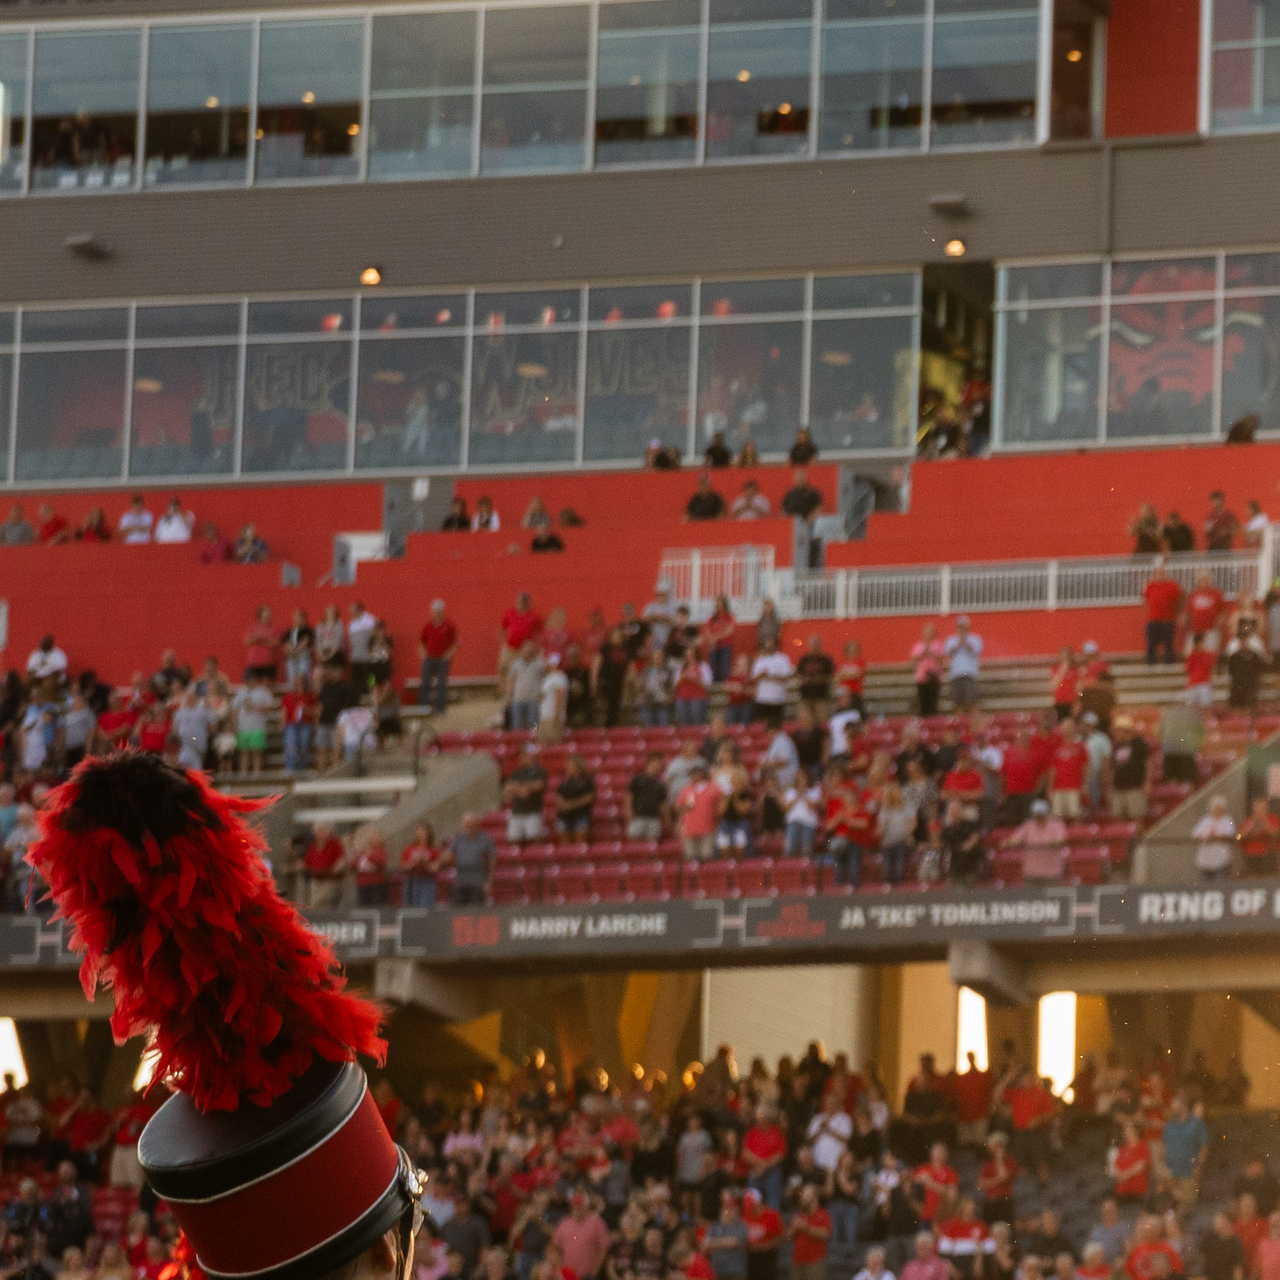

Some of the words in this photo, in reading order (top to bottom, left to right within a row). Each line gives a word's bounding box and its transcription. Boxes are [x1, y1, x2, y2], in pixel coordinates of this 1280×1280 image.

[931, 899, 1061, 926] TOMLINSON
[1139, 892, 1224, 923] RING
[1231, 889, 1268, 915] OF
[511, 916, 580, 940] HARRY
[585, 913, 667, 938] LARCHE
